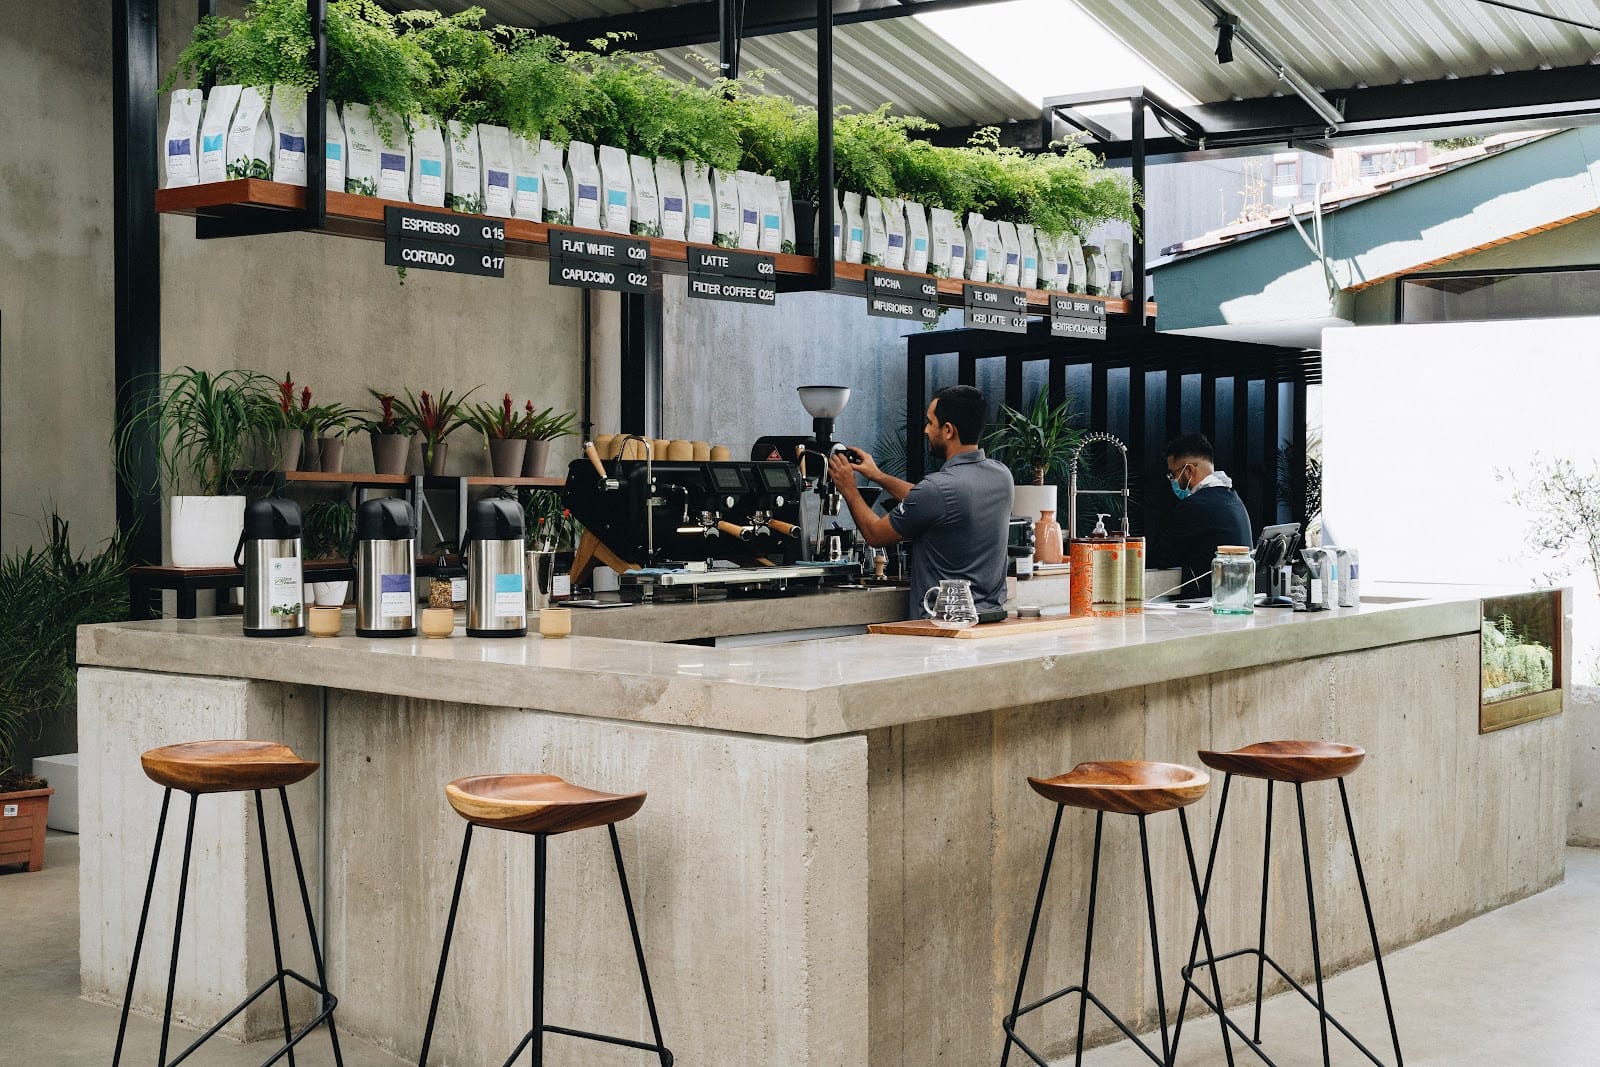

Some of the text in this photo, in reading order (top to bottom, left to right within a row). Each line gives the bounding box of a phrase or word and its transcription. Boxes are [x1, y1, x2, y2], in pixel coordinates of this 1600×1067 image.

[402, 217, 504, 240] ESPRESSO Q15
[402, 248, 504, 269] CORTADO Q17
[562, 240, 647, 260] FLAT WHITE Q20
[701, 255, 774, 275] LATTE Q23
[562, 268, 648, 286] CAPUCCINO Q22
[873, 276, 936, 296] MOCHA Q25
[692, 281, 775, 301] FILTER COFFEE Q25
[974, 291, 982, 302] TE
[984, 292, 998, 304] CHAI
[873, 300, 936, 319] INFUSIONES Q20
[1056, 300, 1072, 310] COLD
[1074, 302, 1090, 312] BREW
[973, 313, 987, 324] ICED
[988, 314, 1006, 325] LATTE
